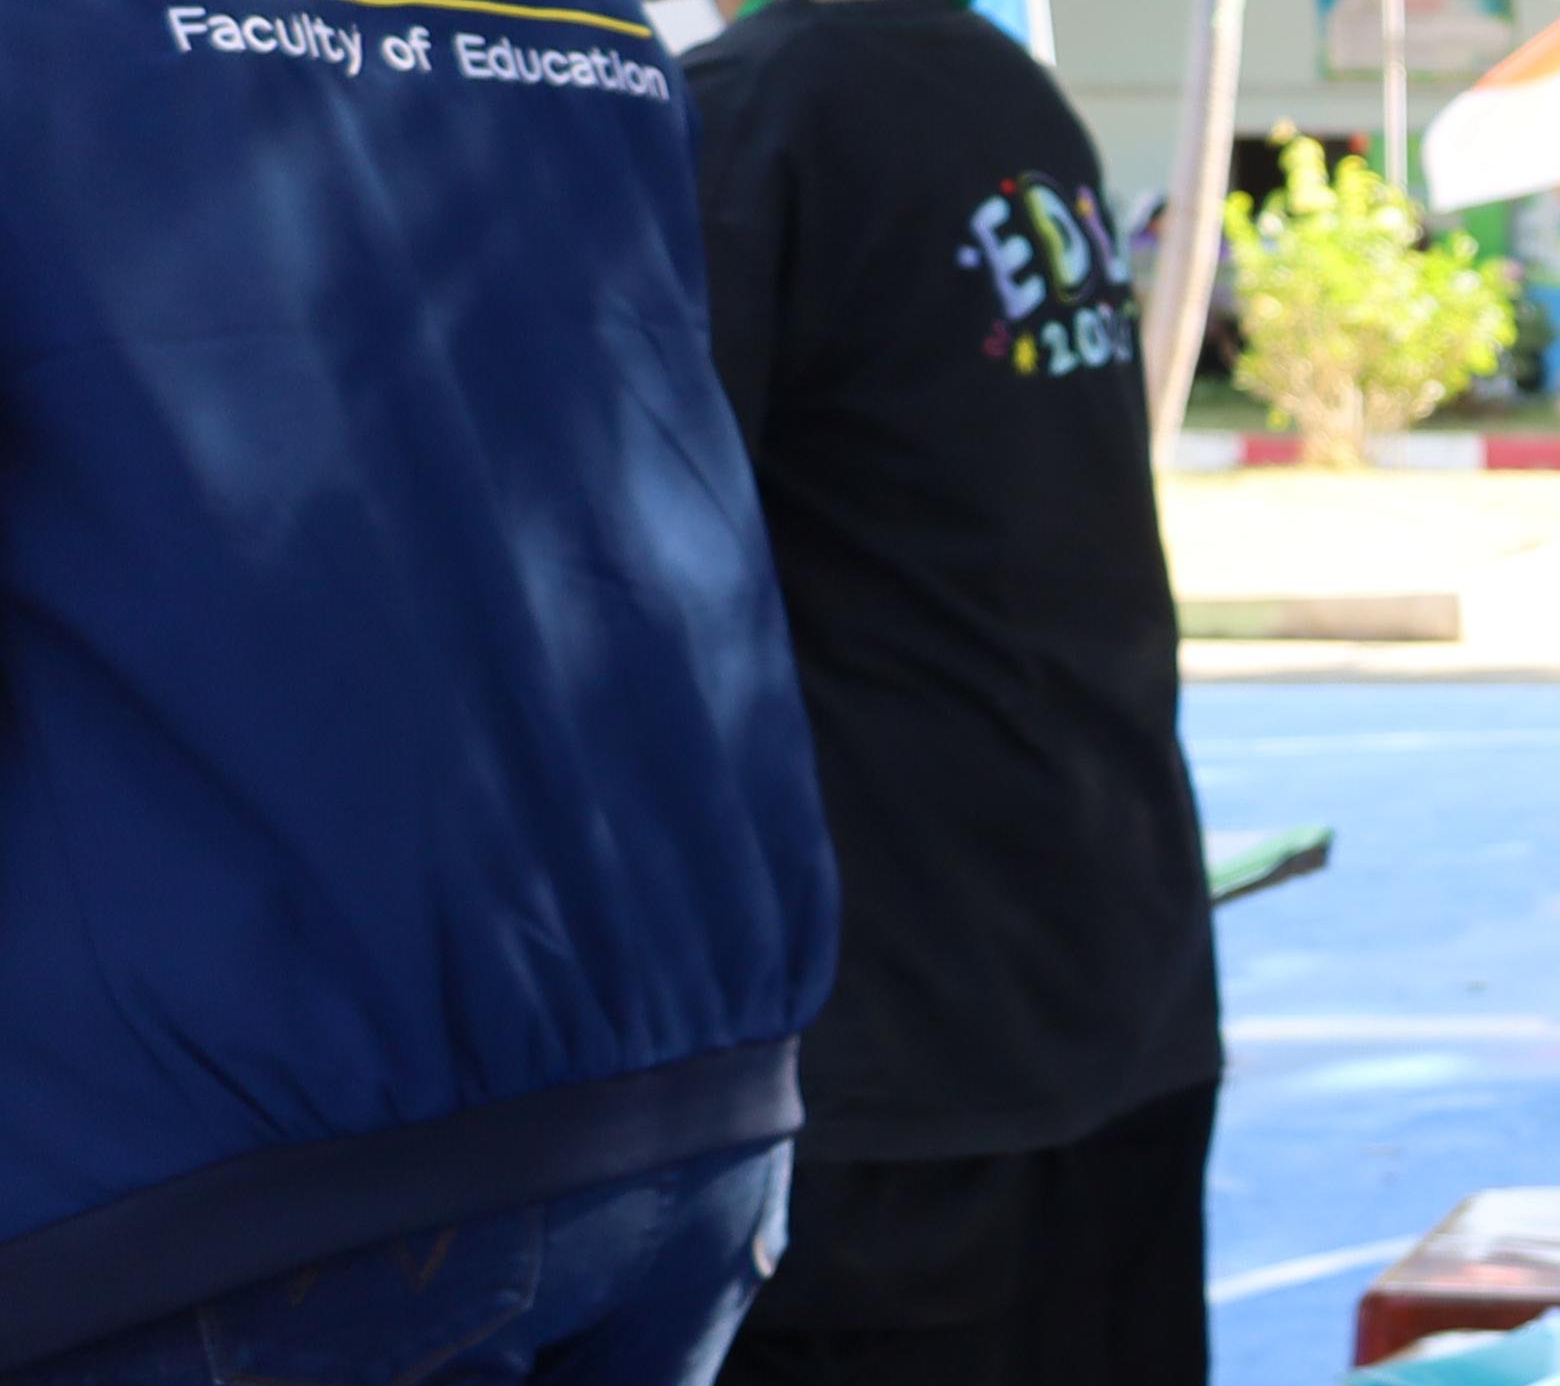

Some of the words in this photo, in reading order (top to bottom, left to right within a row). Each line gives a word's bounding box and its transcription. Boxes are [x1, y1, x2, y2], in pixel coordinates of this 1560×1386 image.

[168, 6, 362, 77] Faculty
[381, 25, 432, 72] of
[455, 32, 669, 101] Education
